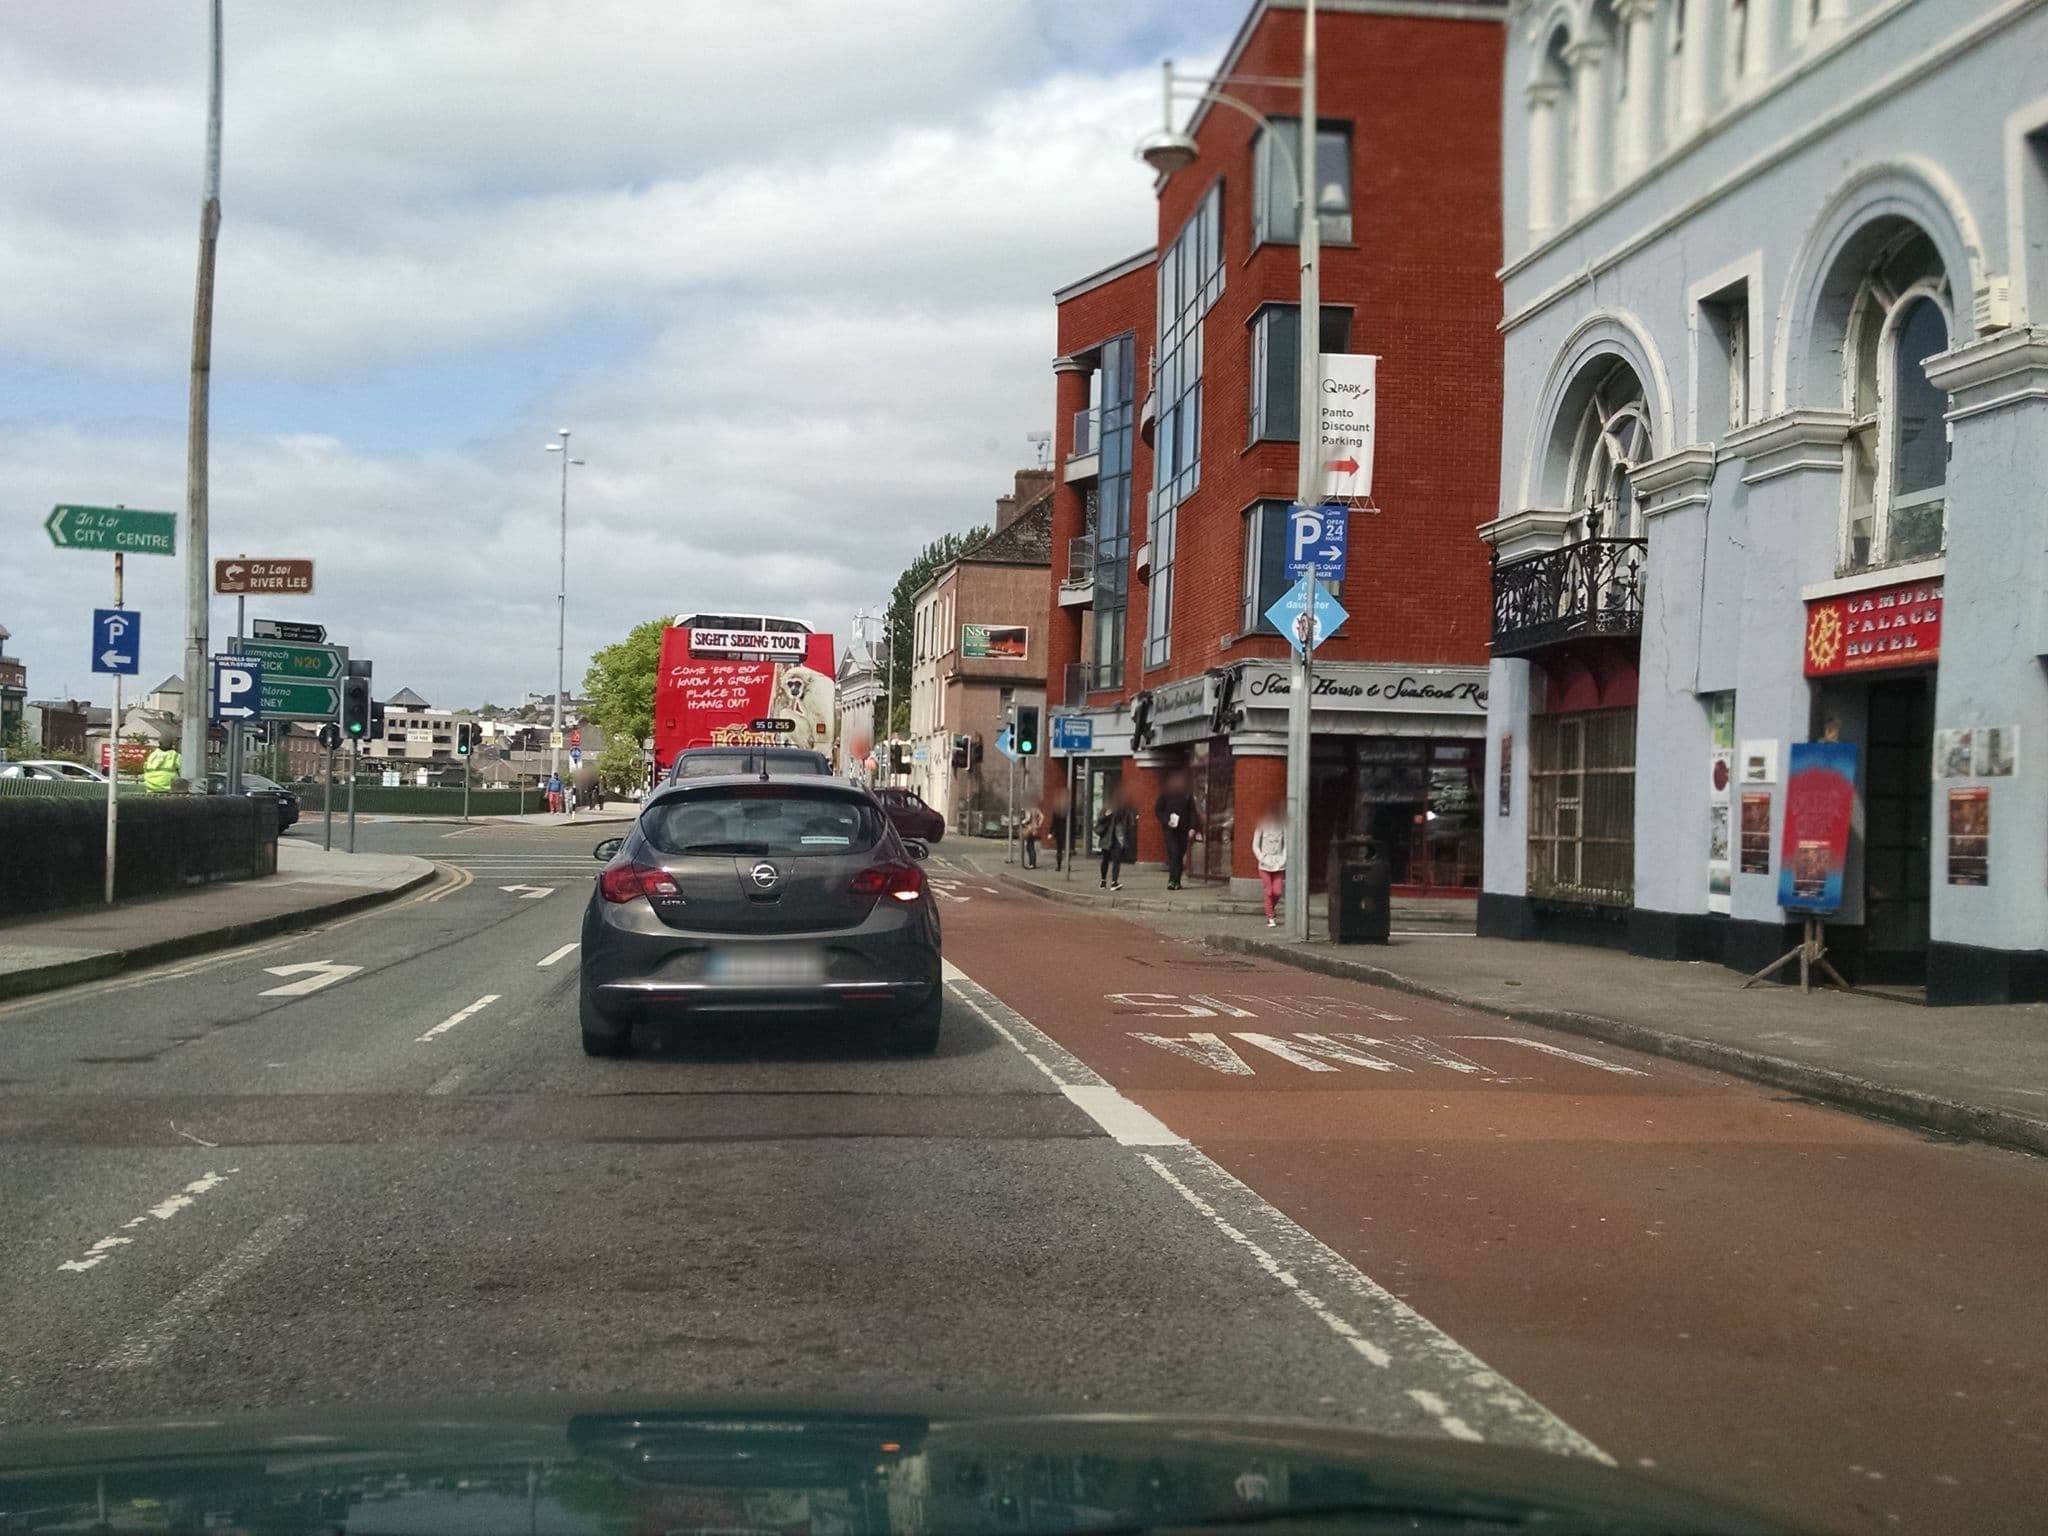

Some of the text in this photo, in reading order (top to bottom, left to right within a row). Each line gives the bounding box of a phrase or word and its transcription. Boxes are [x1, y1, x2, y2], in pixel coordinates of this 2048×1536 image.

[1322, 407, 1354, 418] Panto
[1322, 421, 1371, 433] Discount
[1322, 435, 1364, 448] Parking
[74, 528, 169, 548] CITY CENTRE
[1325, 525, 1344, 537] 24
[1294, 516, 1322, 561] P
[250, 577, 308, 588] RIVER LEE
[1297, 593, 1320, 601] yor
[1847, 587, 1944, 614] CAMDEN
[1846, 608, 1937, 635] PALACE
[109, 622, 125, 645] P
[694, 632, 801, 649] SIGHT SEEING TOUR
[1845, 633, 1918, 657] HOTEL
[671, 666, 706, 675] COME
[738, 665, 760, 674] BOY
[219, 669, 253, 704] P
[677, 676, 710, 688] KNOW
[713, 677, 724, 686] A
[727, 674, 769, 686] GREAT
[1251, 673, 1290, 697] Stea
[1311, 674, 1363, 697] House
[685, 687, 746, 699] PLACE TO
[687, 699, 724, 710] HANG
